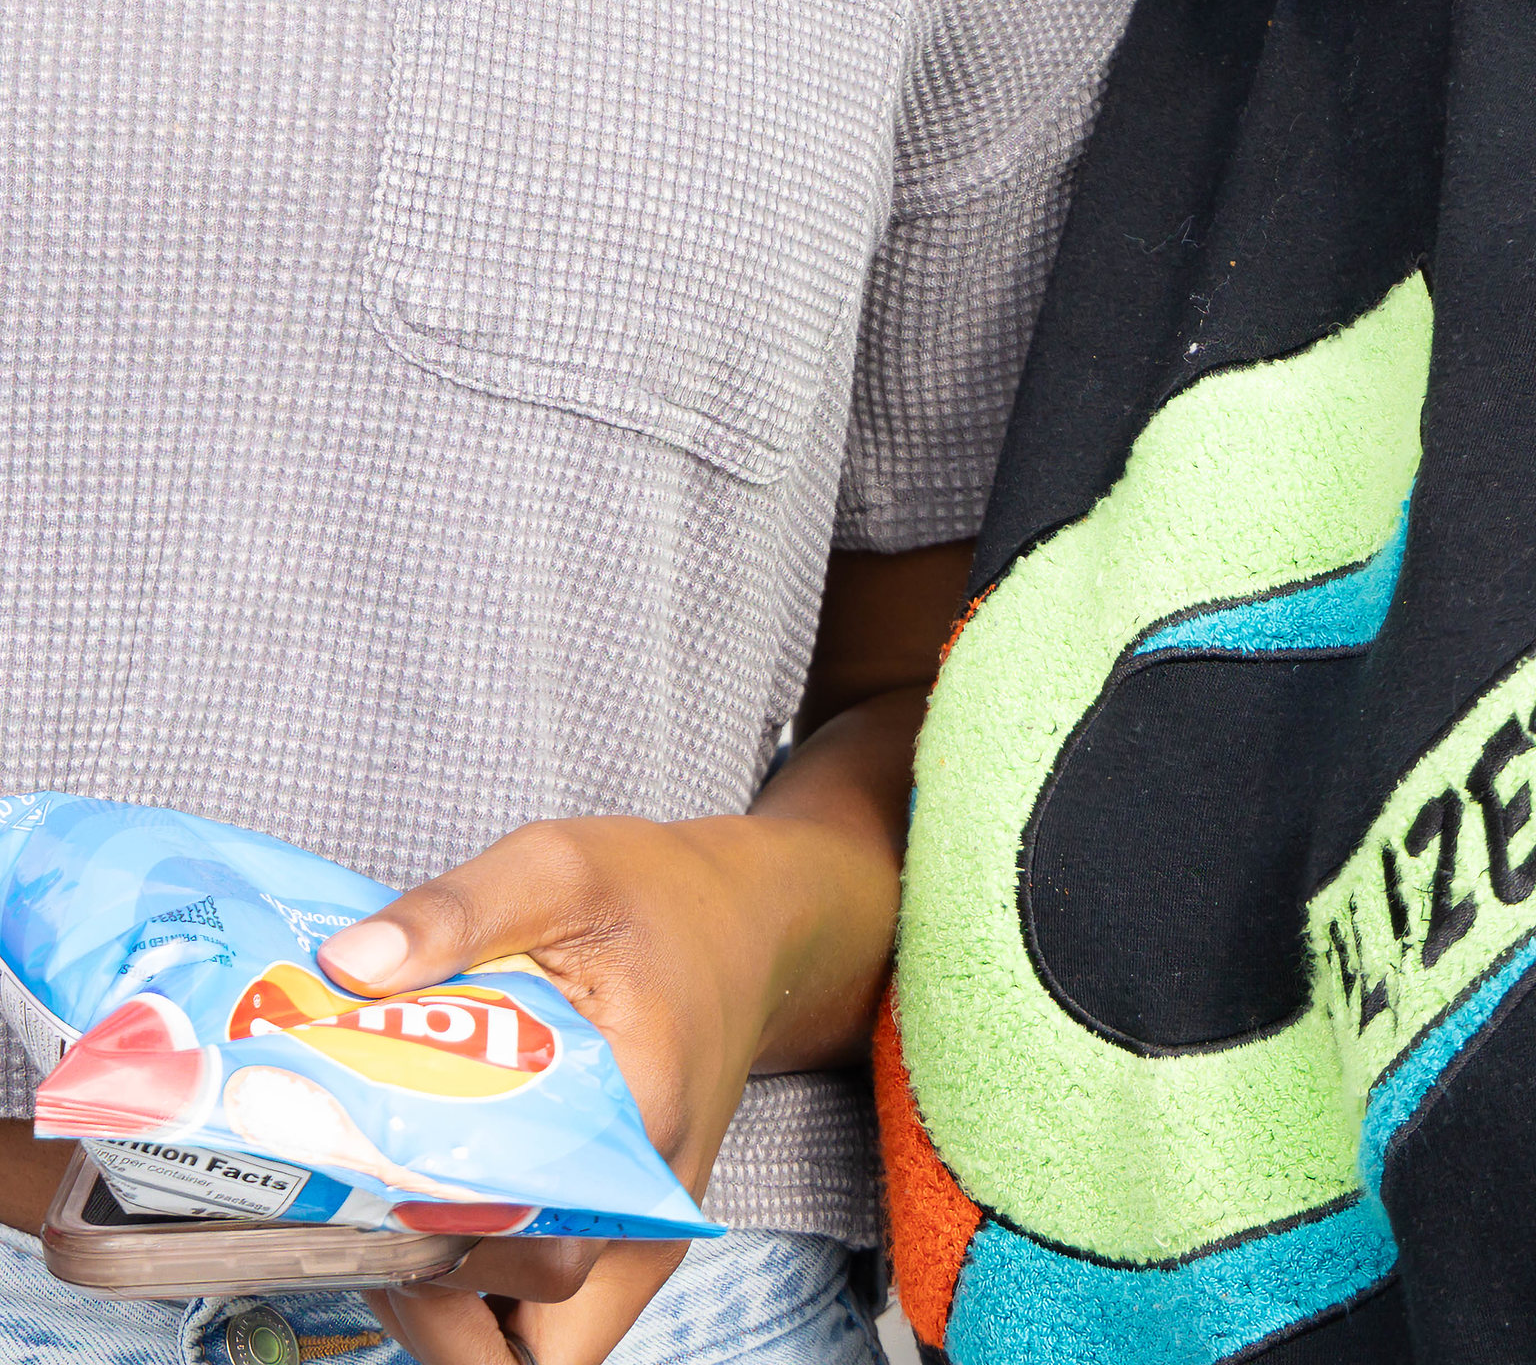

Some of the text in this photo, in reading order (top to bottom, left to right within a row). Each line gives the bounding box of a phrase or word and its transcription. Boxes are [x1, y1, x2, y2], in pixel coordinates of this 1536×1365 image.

[147, 1163, 213, 1189] container
[205, 1155, 289, 1192] Facts
[212, 1191, 272, 1213] package
